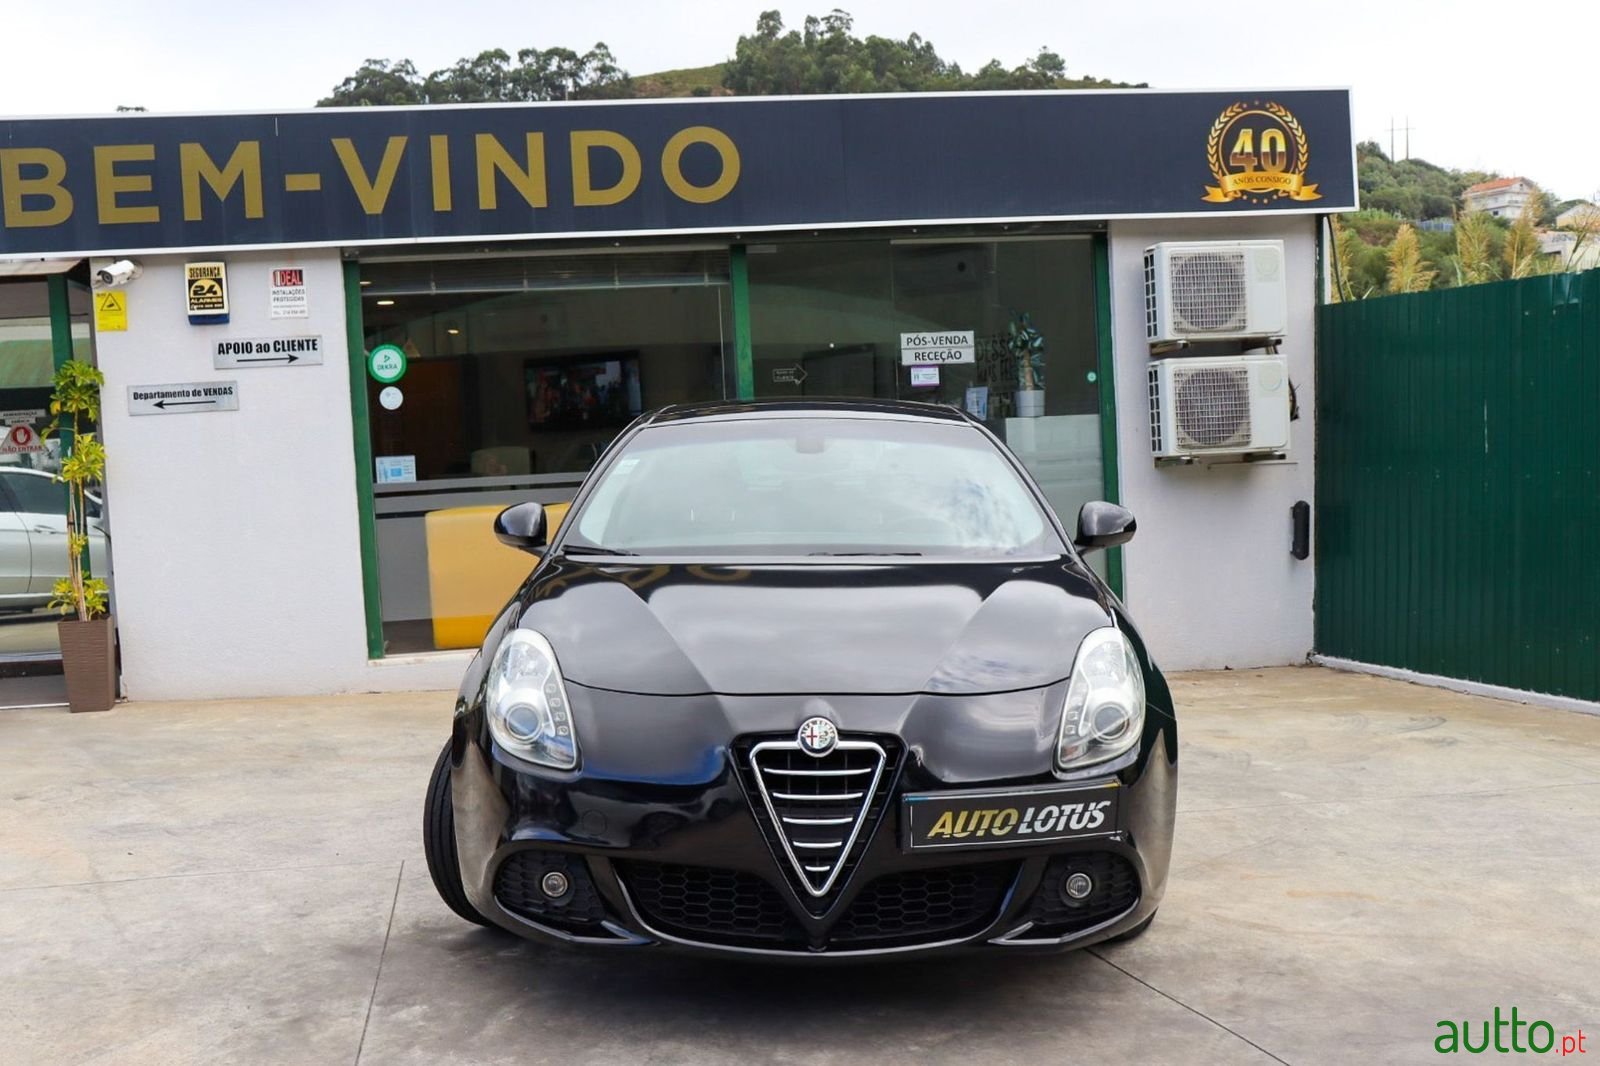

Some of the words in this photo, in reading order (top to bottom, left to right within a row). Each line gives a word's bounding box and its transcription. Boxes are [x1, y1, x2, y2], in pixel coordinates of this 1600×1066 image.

[1229, 128, 1287, 172] 40
[0, 126, 741, 228] BEM-VINDO
[1255, 175, 1292, 185] CONSIGO
[274, 270, 302, 286] IDEAL
[192, 284, 218, 296] 24
[217, 341, 253, 355] APOIO
[255, 343, 270, 354] ao
[273, 339, 318, 352] CLIENTE
[906, 334, 968, 346] PÓS-VENDA
[914, 348, 962, 362] RECEÇÃO
[132, 389, 190, 401] Departamento
[191, 388, 202, 397] de
[203, 386, 233, 396] VENDAS
